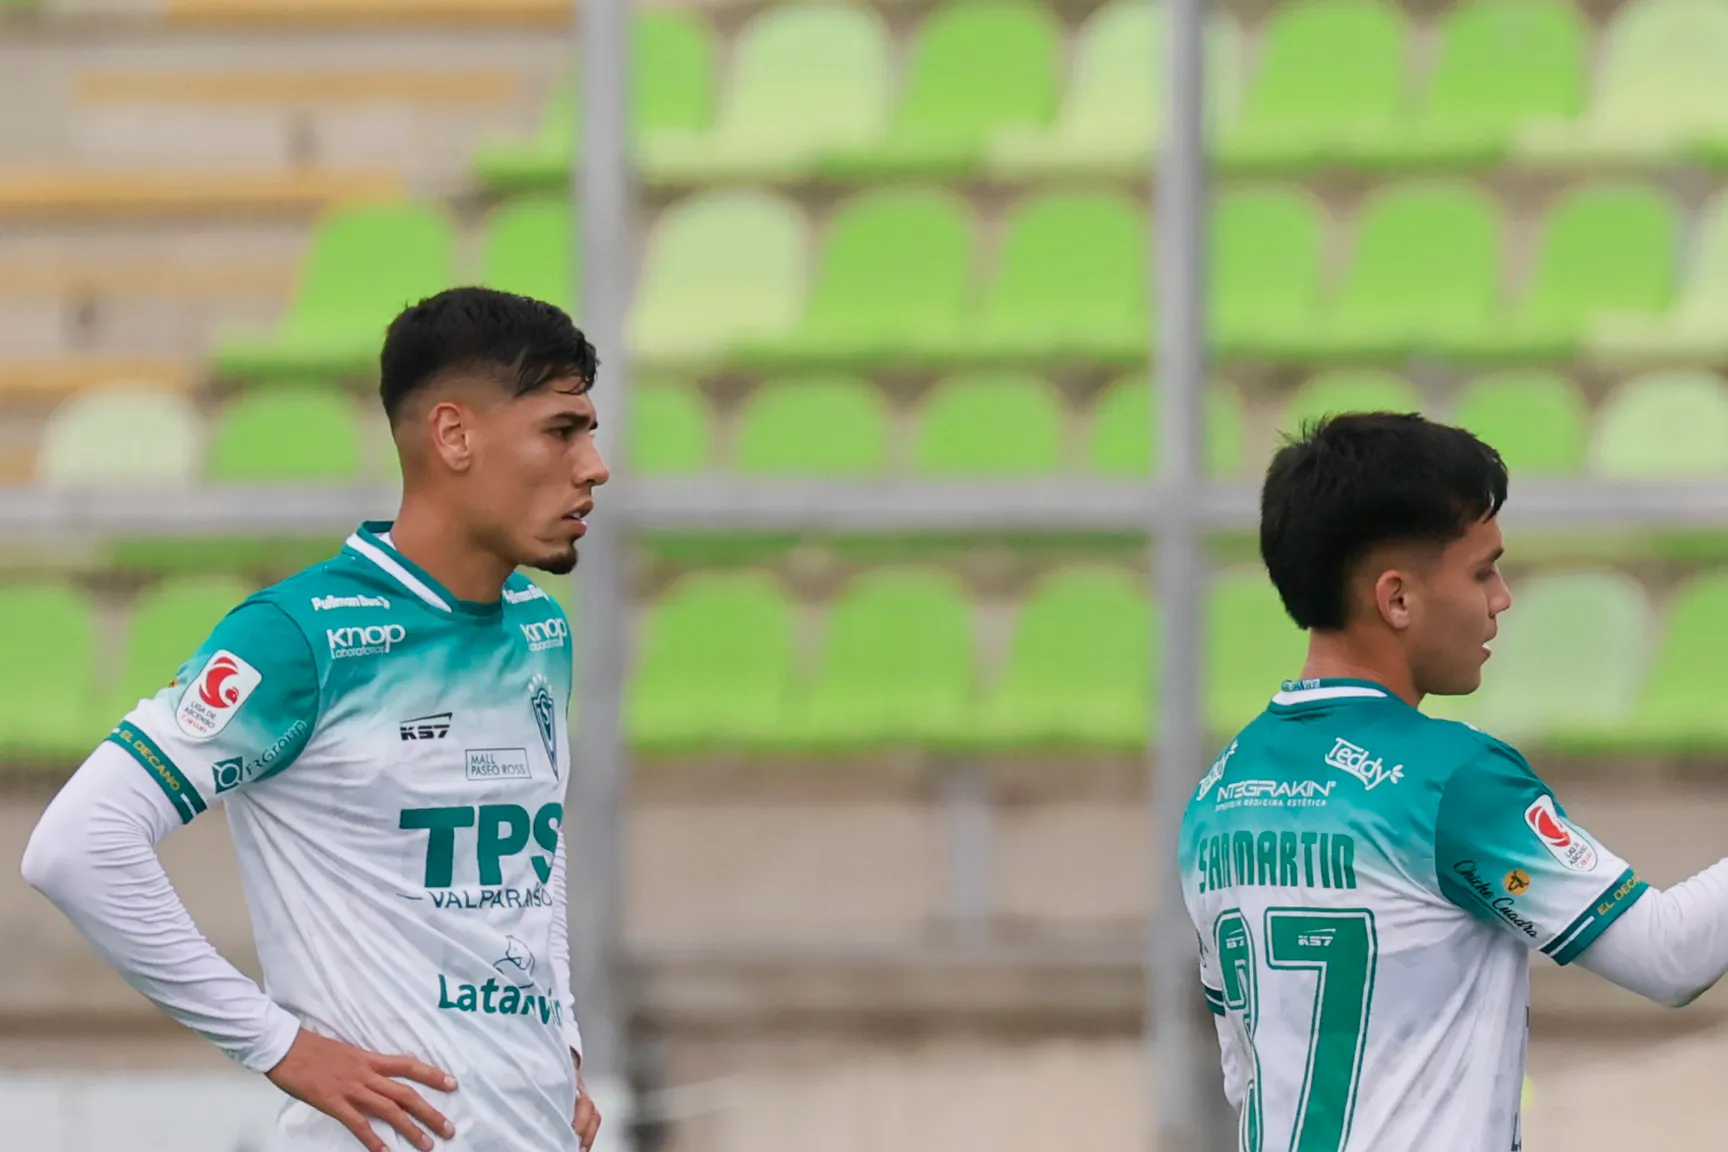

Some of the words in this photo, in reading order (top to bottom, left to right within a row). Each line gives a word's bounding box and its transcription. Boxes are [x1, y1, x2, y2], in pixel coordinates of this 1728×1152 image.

[133, 739, 180, 791] DECANO
[470, 753, 495, 765] MALL
[471, 763, 499, 776] PASEO
[502, 764, 526, 775] ROSS
[1326, 737, 1391, 790] Teddy
[399, 802, 564, 888] TPS
[1492, 897, 1538, 938] Cuadra
